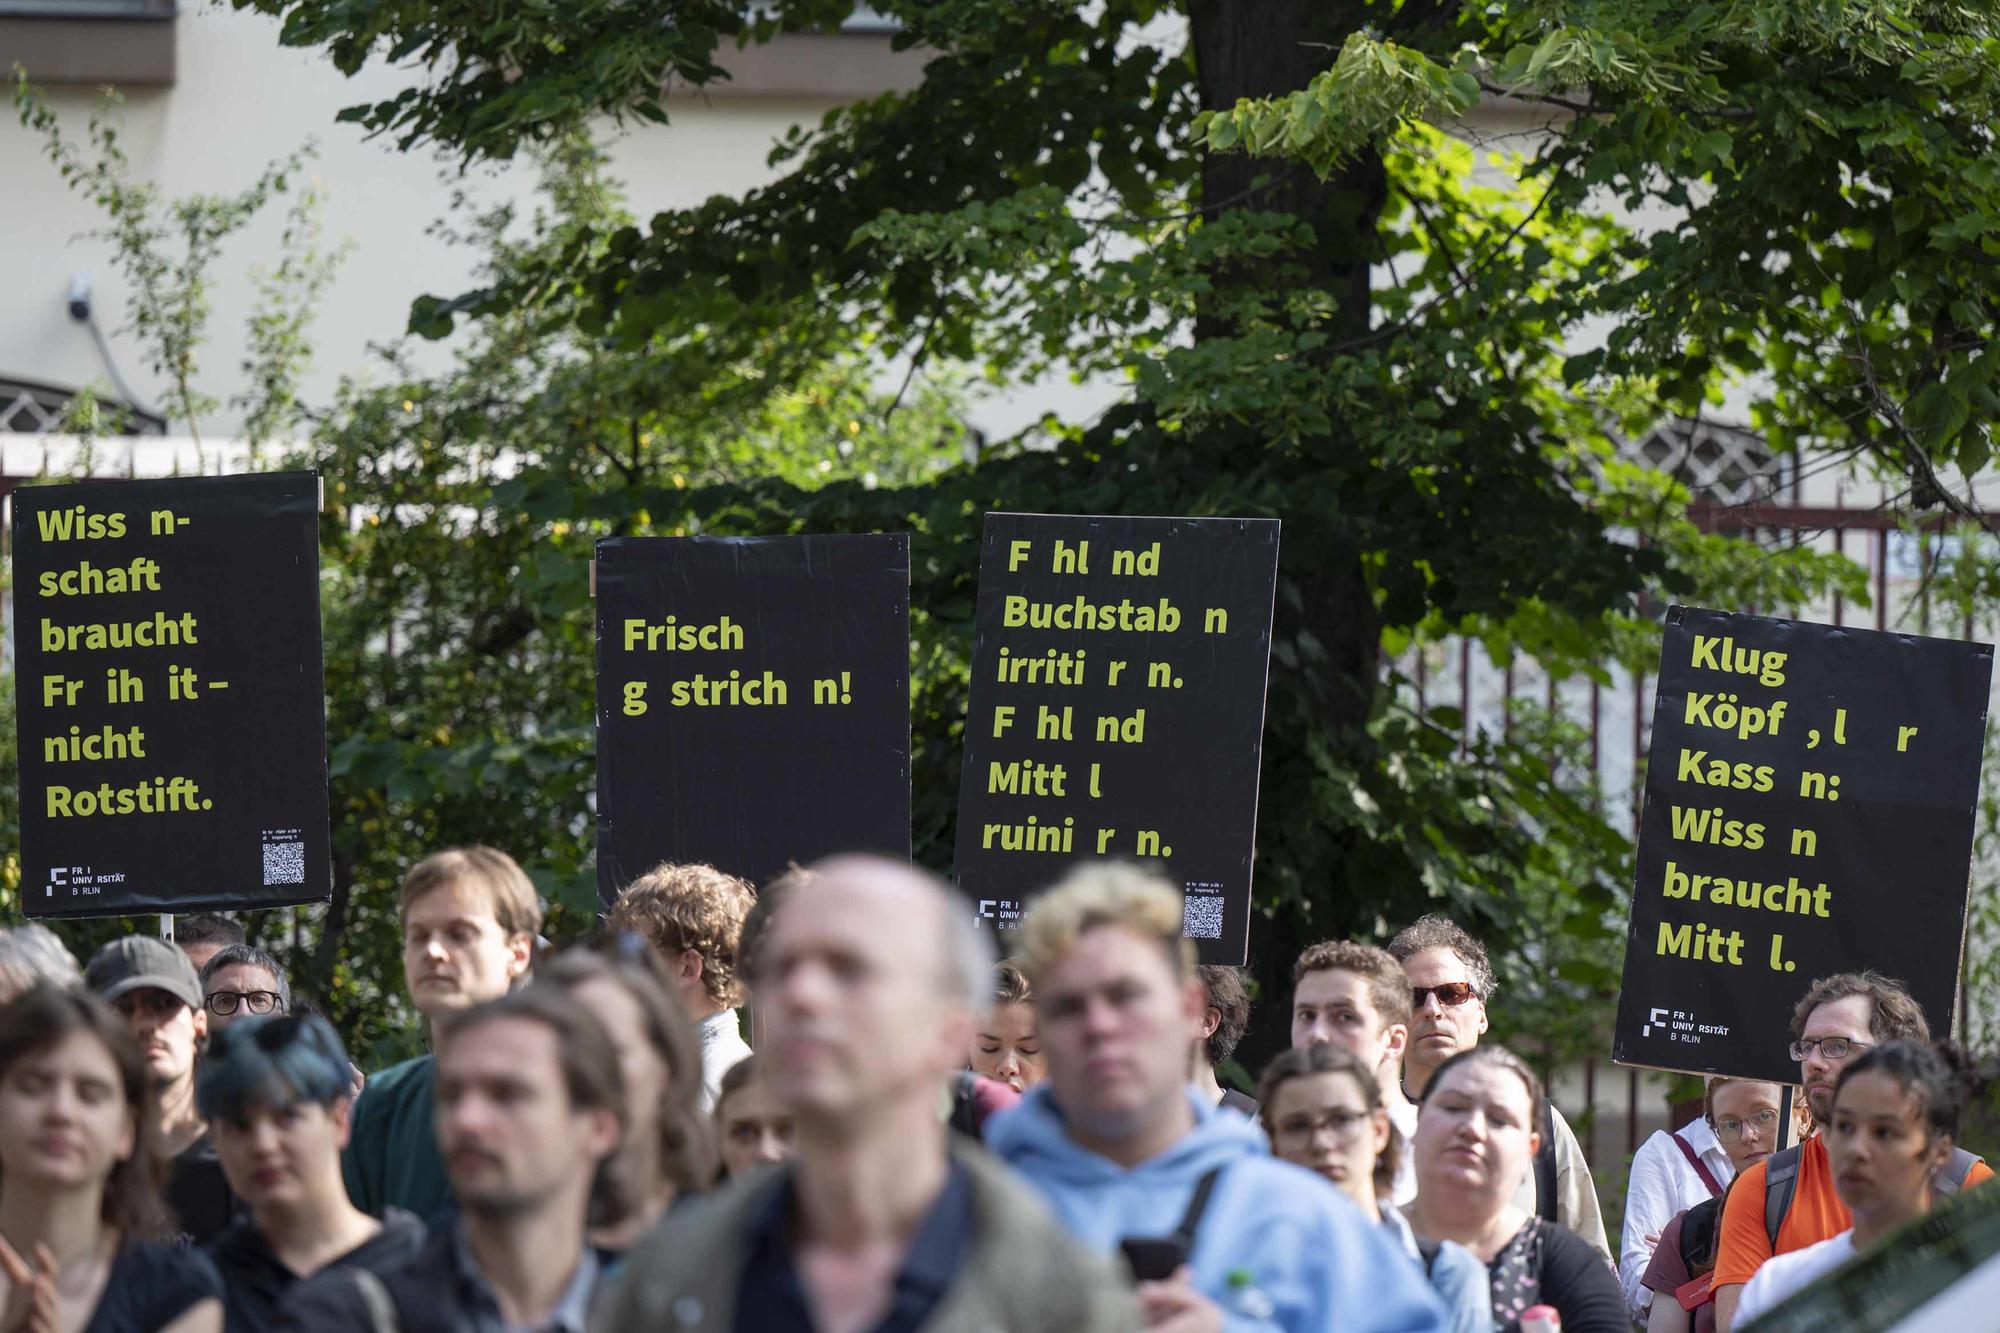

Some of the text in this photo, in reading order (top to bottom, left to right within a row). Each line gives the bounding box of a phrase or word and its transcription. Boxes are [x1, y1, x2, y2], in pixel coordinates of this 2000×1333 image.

[37, 505, 190, 541] Wiss n-
[39, 557, 161, 597] schaft
[1008, 540, 1161, 577] F hl nd
[41, 612, 198, 652] braucht
[624, 615, 744, 651] Frisch
[1003, 595, 1228, 634] Buchstab n
[997, 648, 1184, 689] irriti r n.
[1691, 635, 1788, 688] Klug
[43, 675, 84, 707] Fr
[107, 667, 144, 704] ih
[169, 664, 198, 700] it
[623, 671, 852, 717] g strich n!
[993, 705, 1146, 743] F hl nd
[1684, 692, 1788, 740] Köpf
[1897, 726, 1918, 752] r
[44, 725, 145, 762] nicht
[988, 760, 1067, 797] Mitt
[1677, 748, 1841, 801] Kass n:
[47, 776, 213, 818] Rotstift.
[983, 816, 1172, 857] ruini r n.
[1671, 806, 1817, 857] Wiss n
[72, 866, 83, 875] FR
[72, 873, 125, 885] UNIV RSITÄT
[1663, 861, 1832, 918] braucht
[82, 886, 101, 895] RLIN
[1656, 921, 1745, 966] Mitt
[1672, 1021, 1730, 1036] UNIV RSITÄT
[1673, 1011, 1685, 1020] FR
[1681, 1033, 1701, 1044] RLIN
